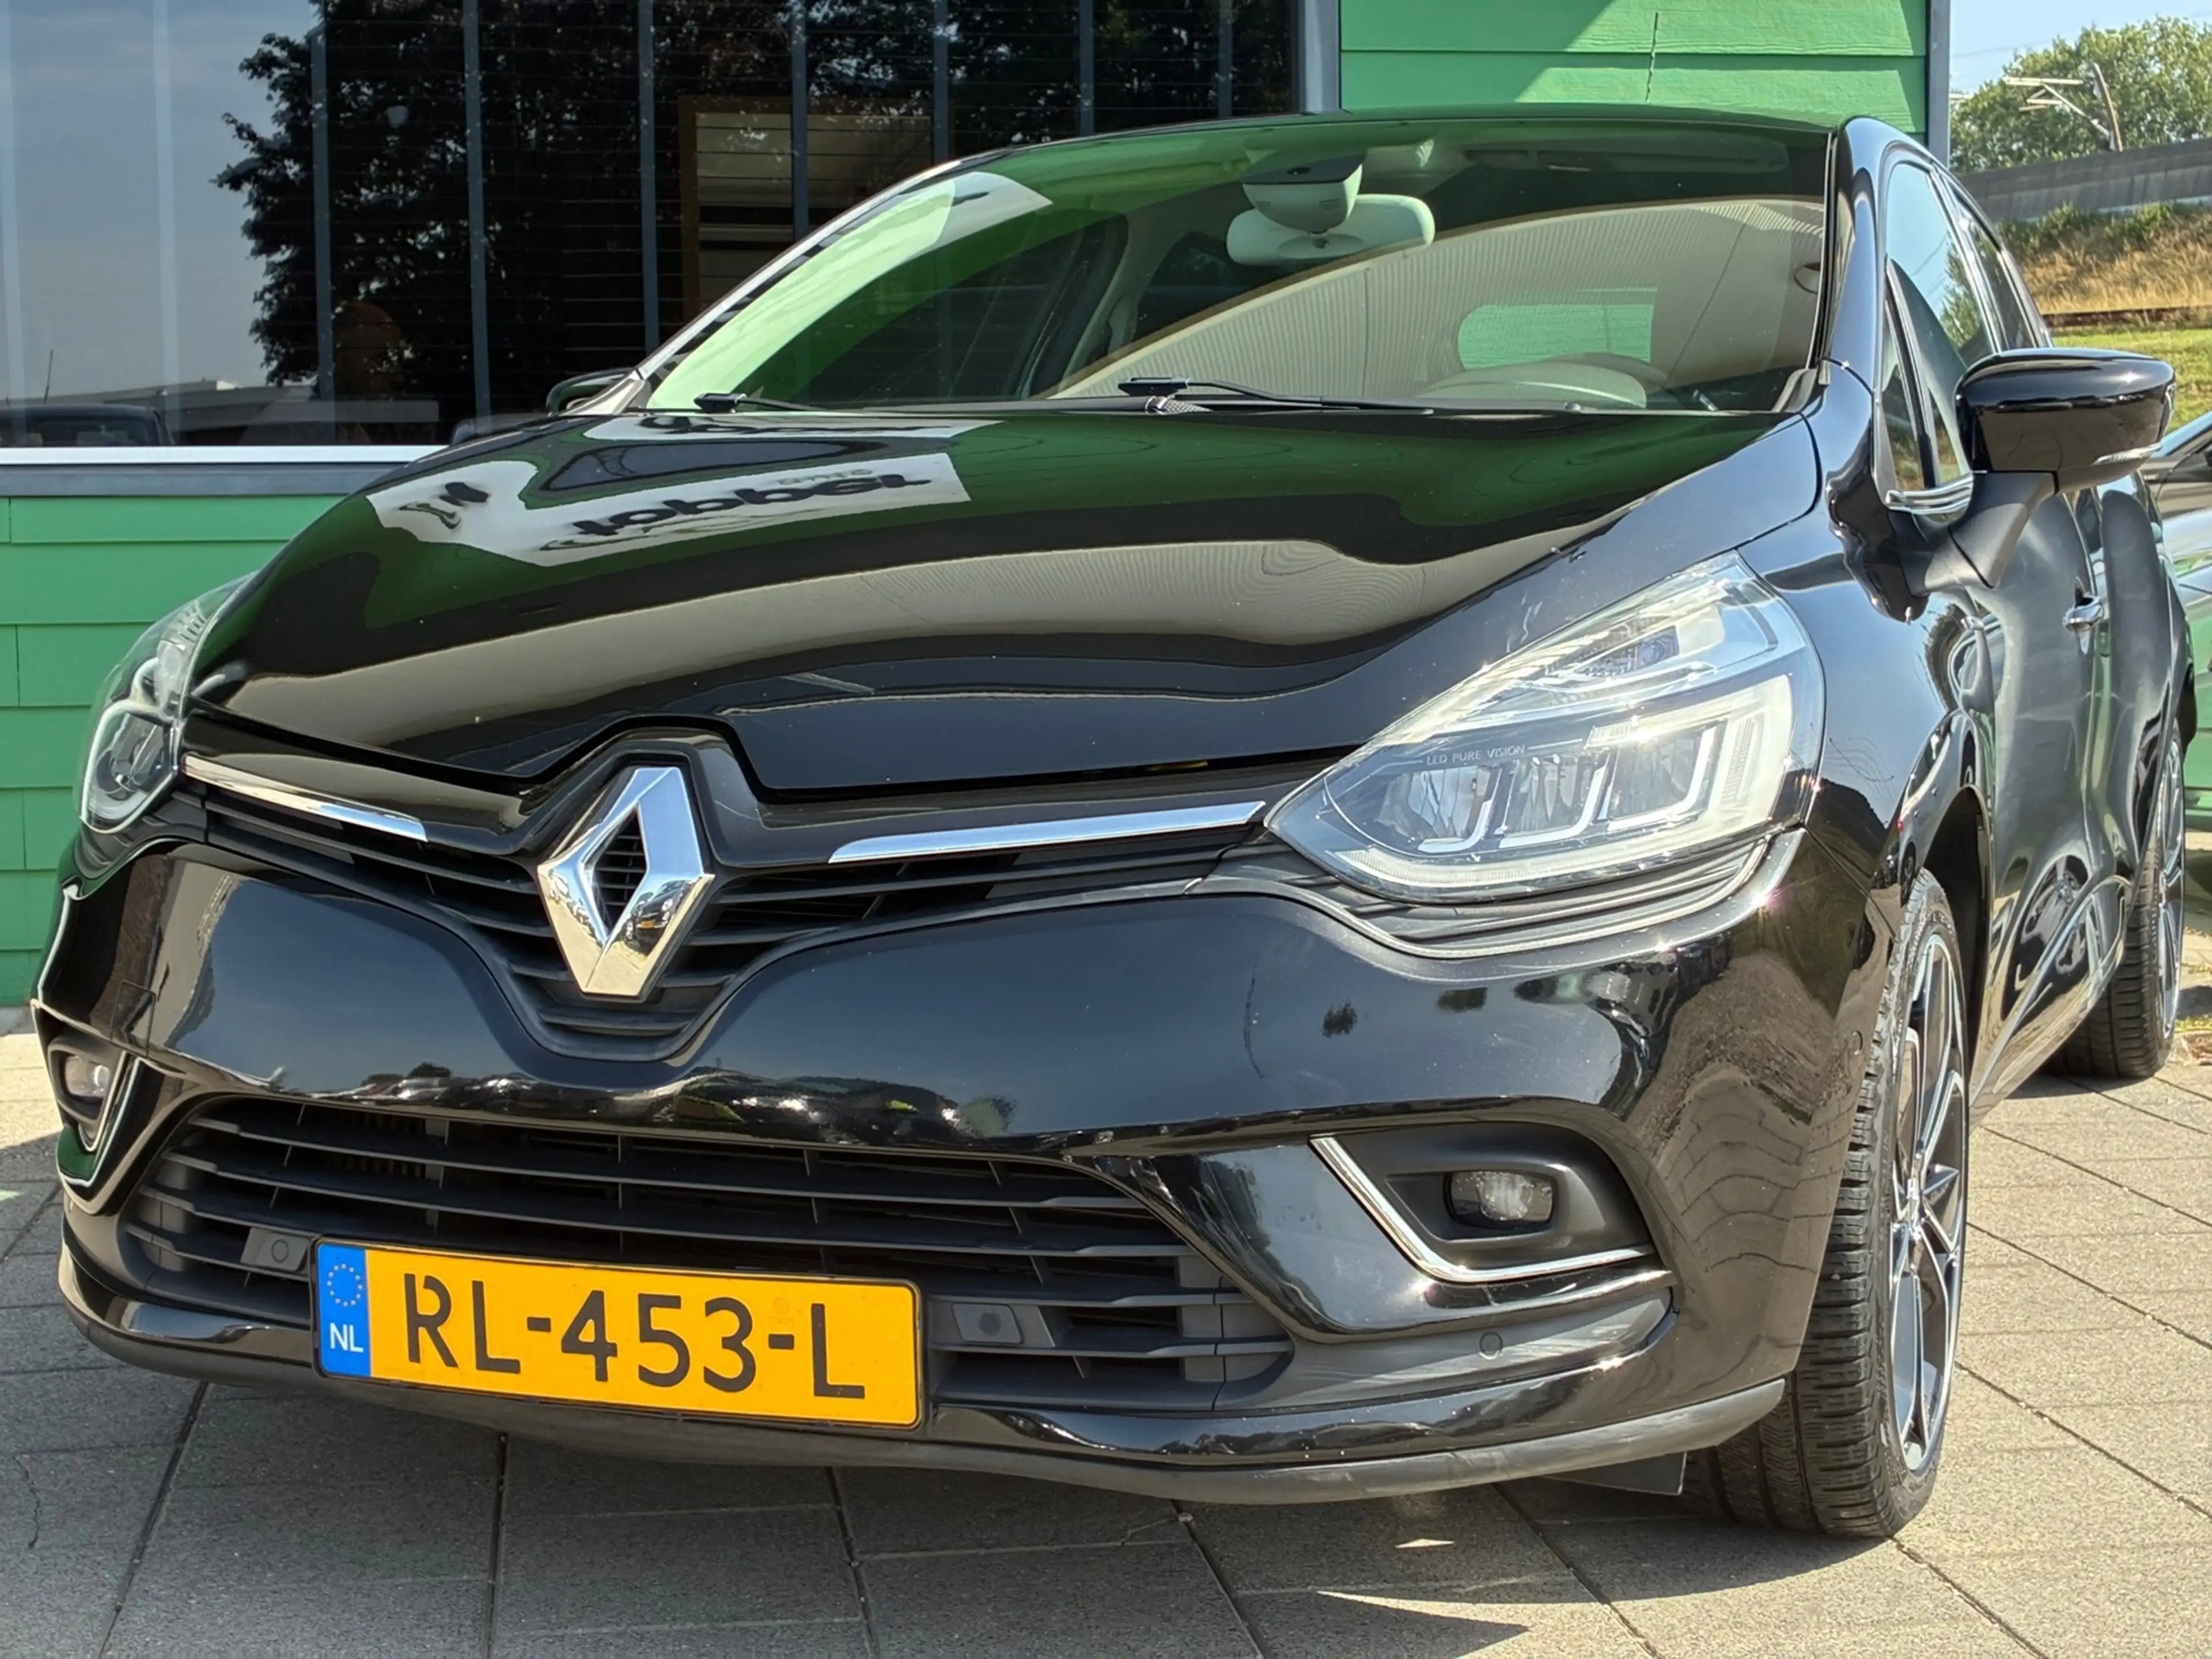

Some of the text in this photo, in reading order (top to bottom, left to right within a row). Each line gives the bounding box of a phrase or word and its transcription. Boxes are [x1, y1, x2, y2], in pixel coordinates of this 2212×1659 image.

[1426, 745, 1525, 765] LED PURE VISION
[329, 1322, 364, 1353] NL
[404, 1272, 866, 1400] RL-453-L
